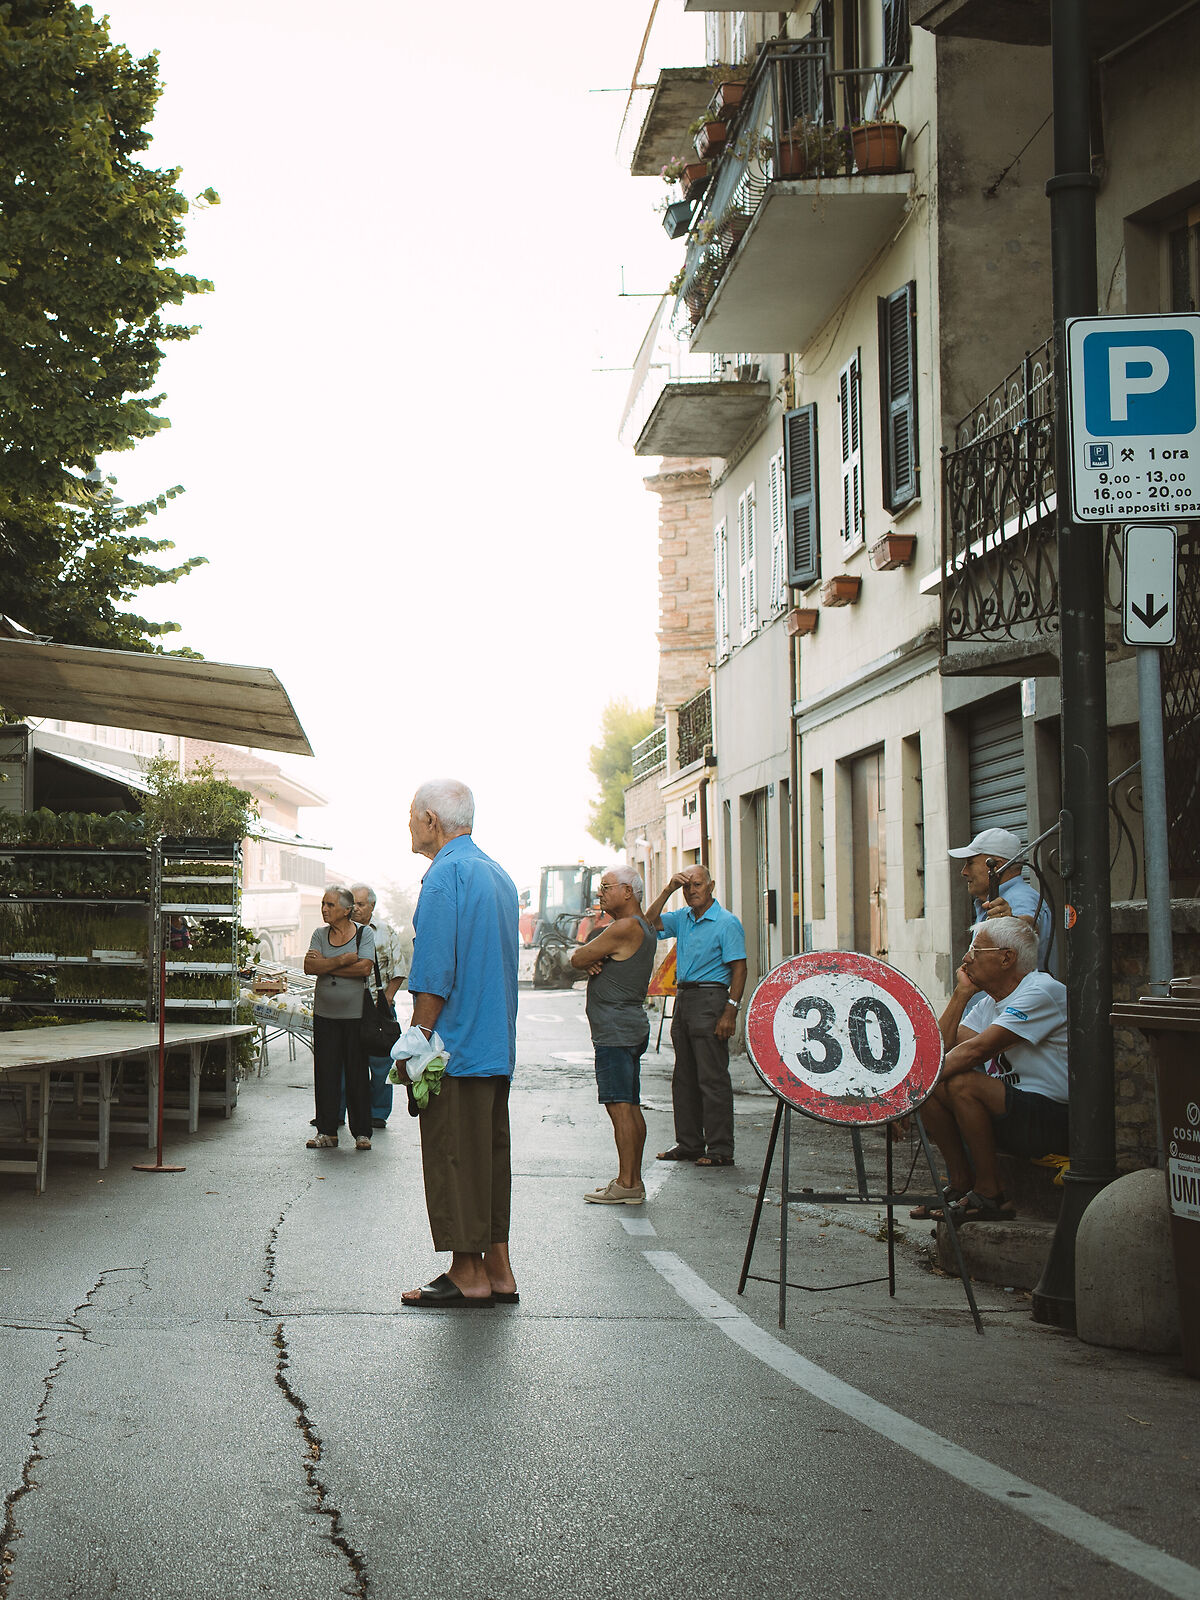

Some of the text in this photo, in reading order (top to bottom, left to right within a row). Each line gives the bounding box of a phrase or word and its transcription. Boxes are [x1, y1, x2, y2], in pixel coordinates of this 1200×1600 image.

[1108, 345, 1170, 421] P
[1148, 447, 1189, 460] 1 ora
[1082, 504, 1114, 515] negli
[1118, 502, 1170, 514] appositi
[792, 995, 901, 1075] 30
